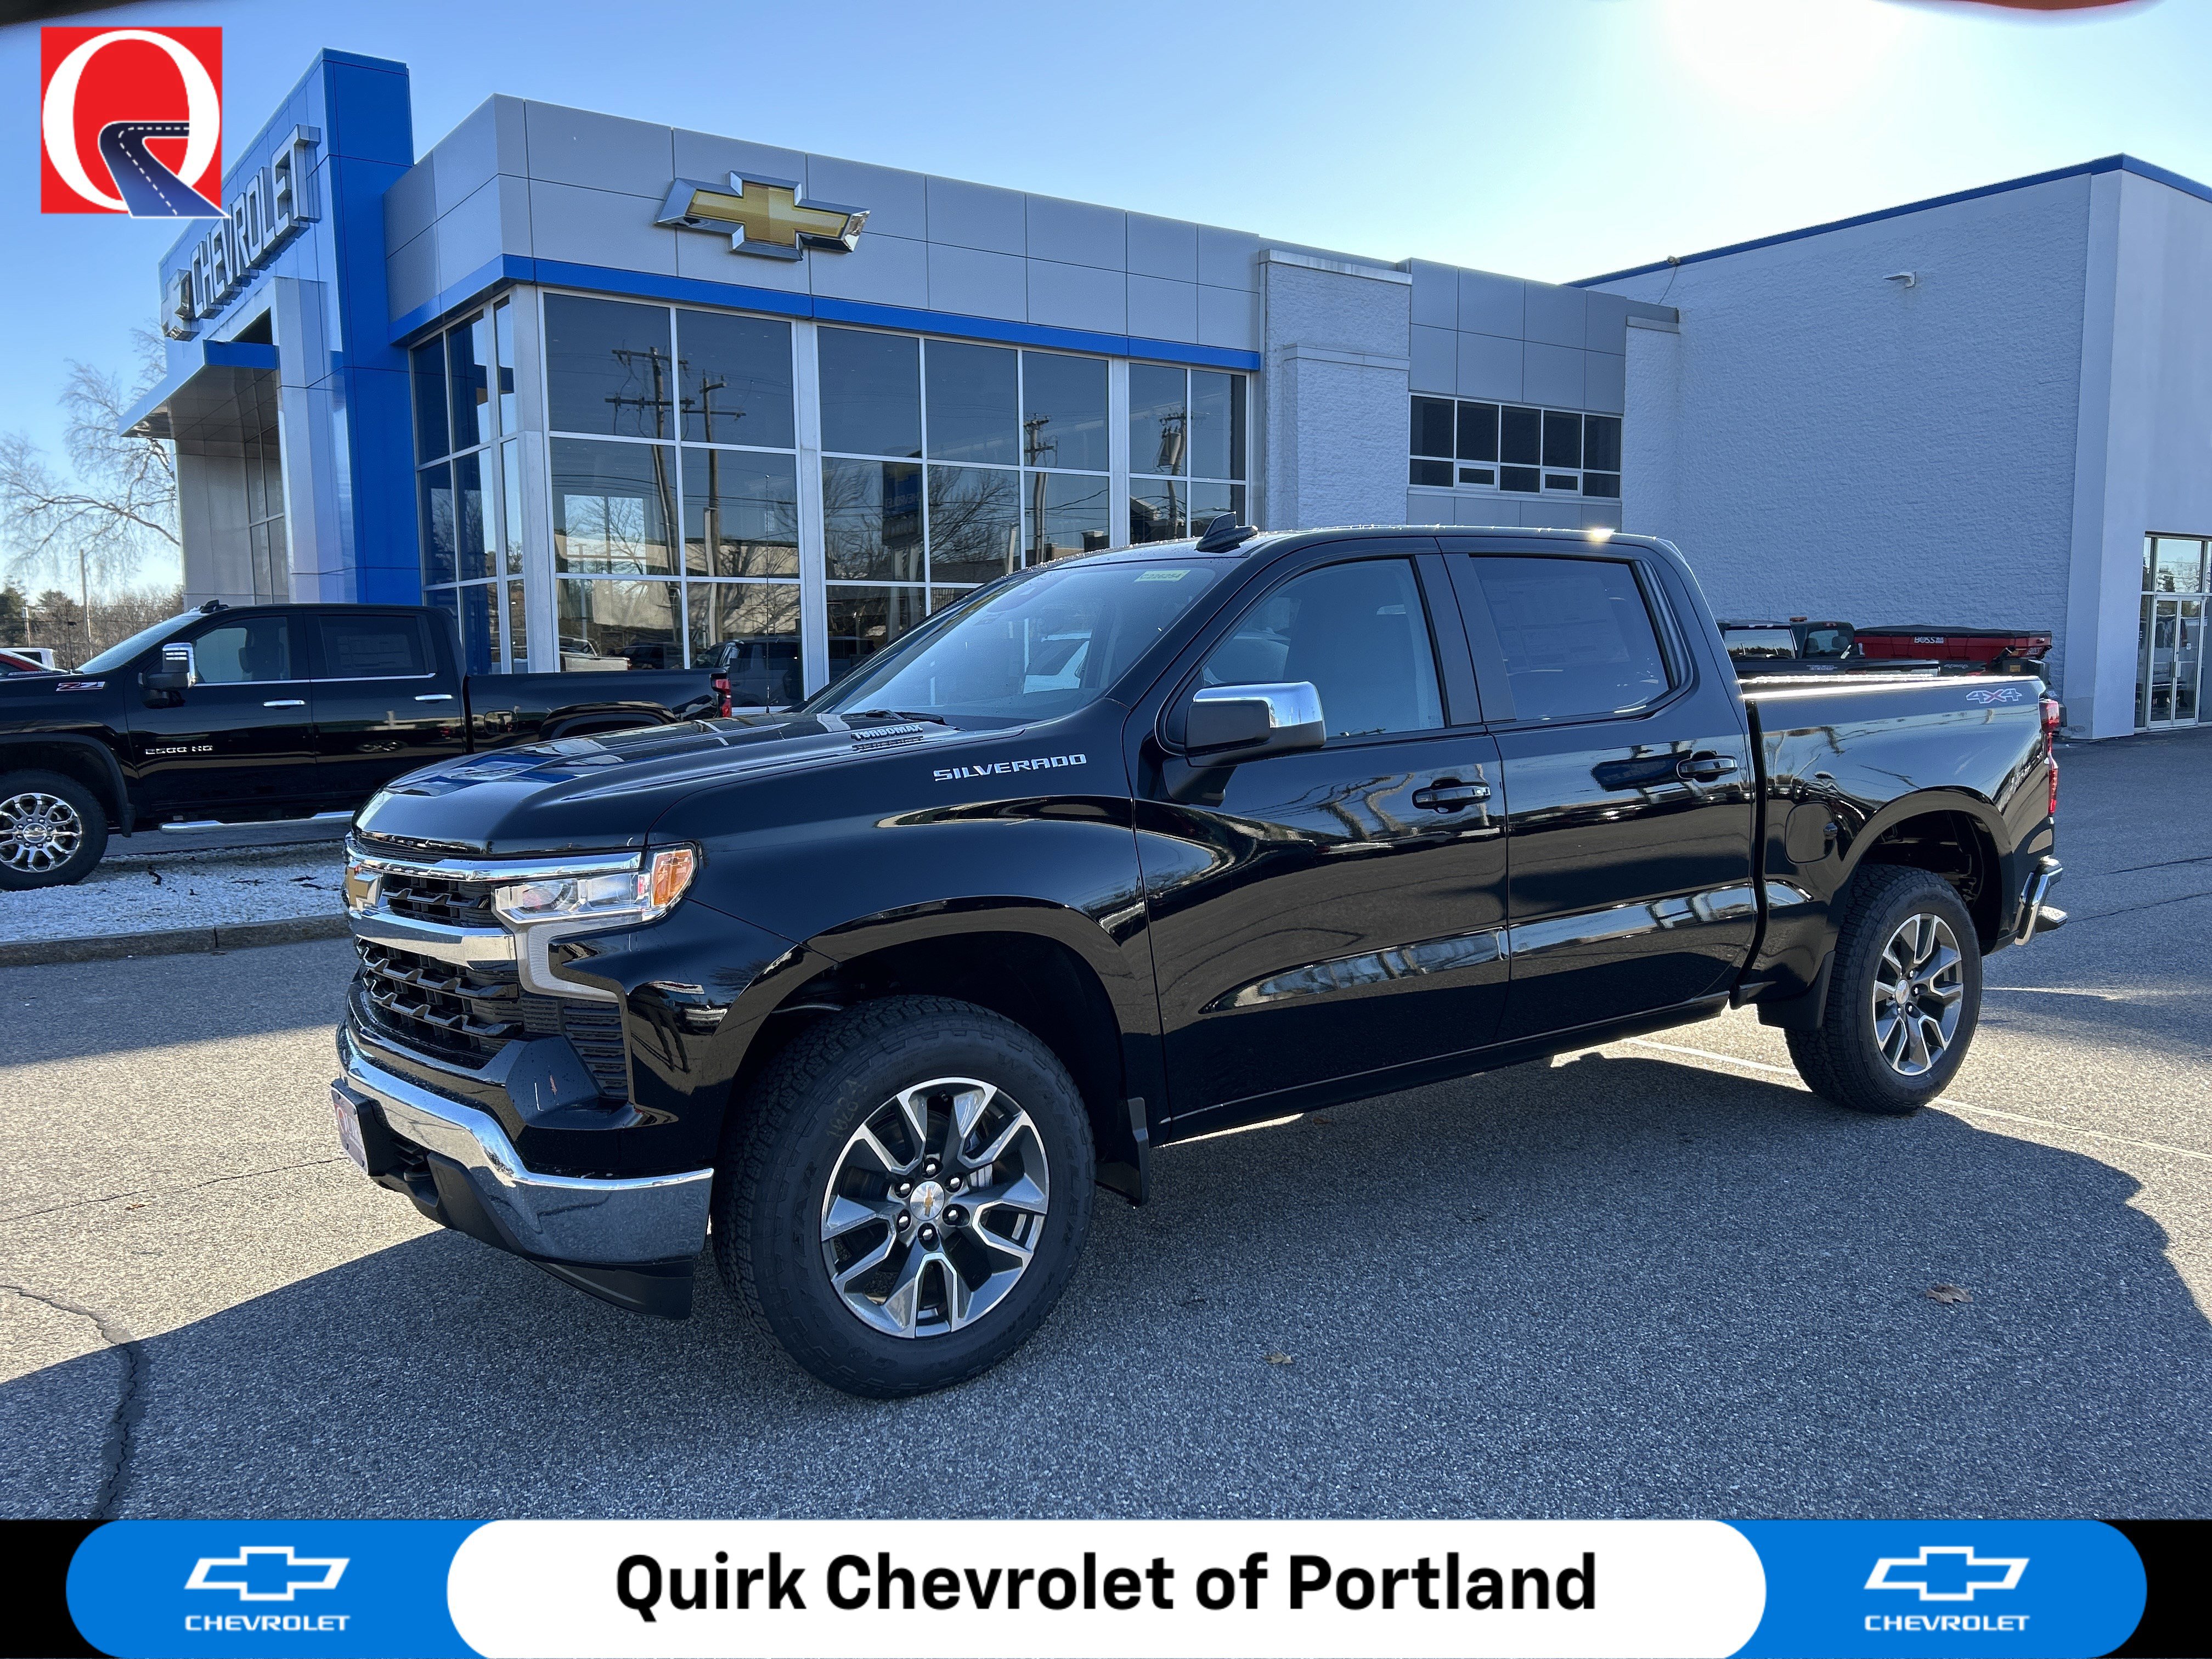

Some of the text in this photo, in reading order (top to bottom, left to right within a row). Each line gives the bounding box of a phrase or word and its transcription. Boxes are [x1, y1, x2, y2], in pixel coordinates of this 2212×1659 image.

[190, 124, 320, 319] CHEVROLET
[851, 724, 923, 741] TURBOMAX
[145, 747, 187, 755] 2500
[933, 754, 1087, 782] SILVERADO
